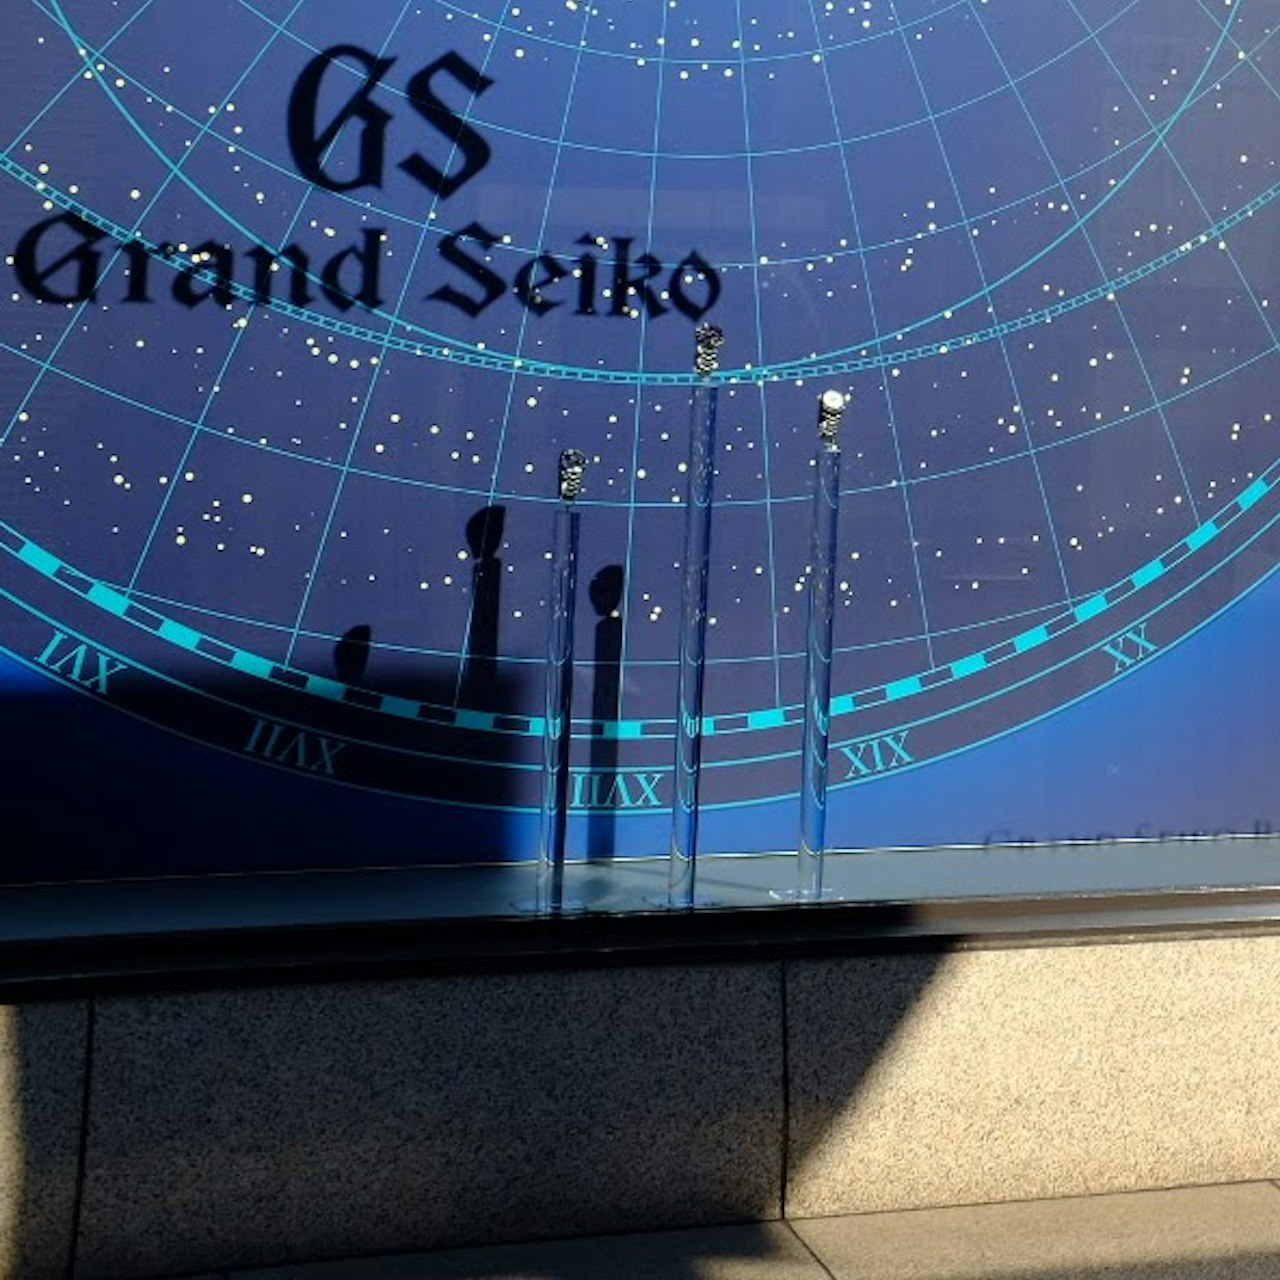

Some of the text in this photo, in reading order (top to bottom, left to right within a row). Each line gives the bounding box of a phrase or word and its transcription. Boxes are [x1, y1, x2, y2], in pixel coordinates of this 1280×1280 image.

[286, 41, 498, 203] GS
[11, 208, 724, 322] Grand Seiko
[839, 730, 915, 780] XIX
